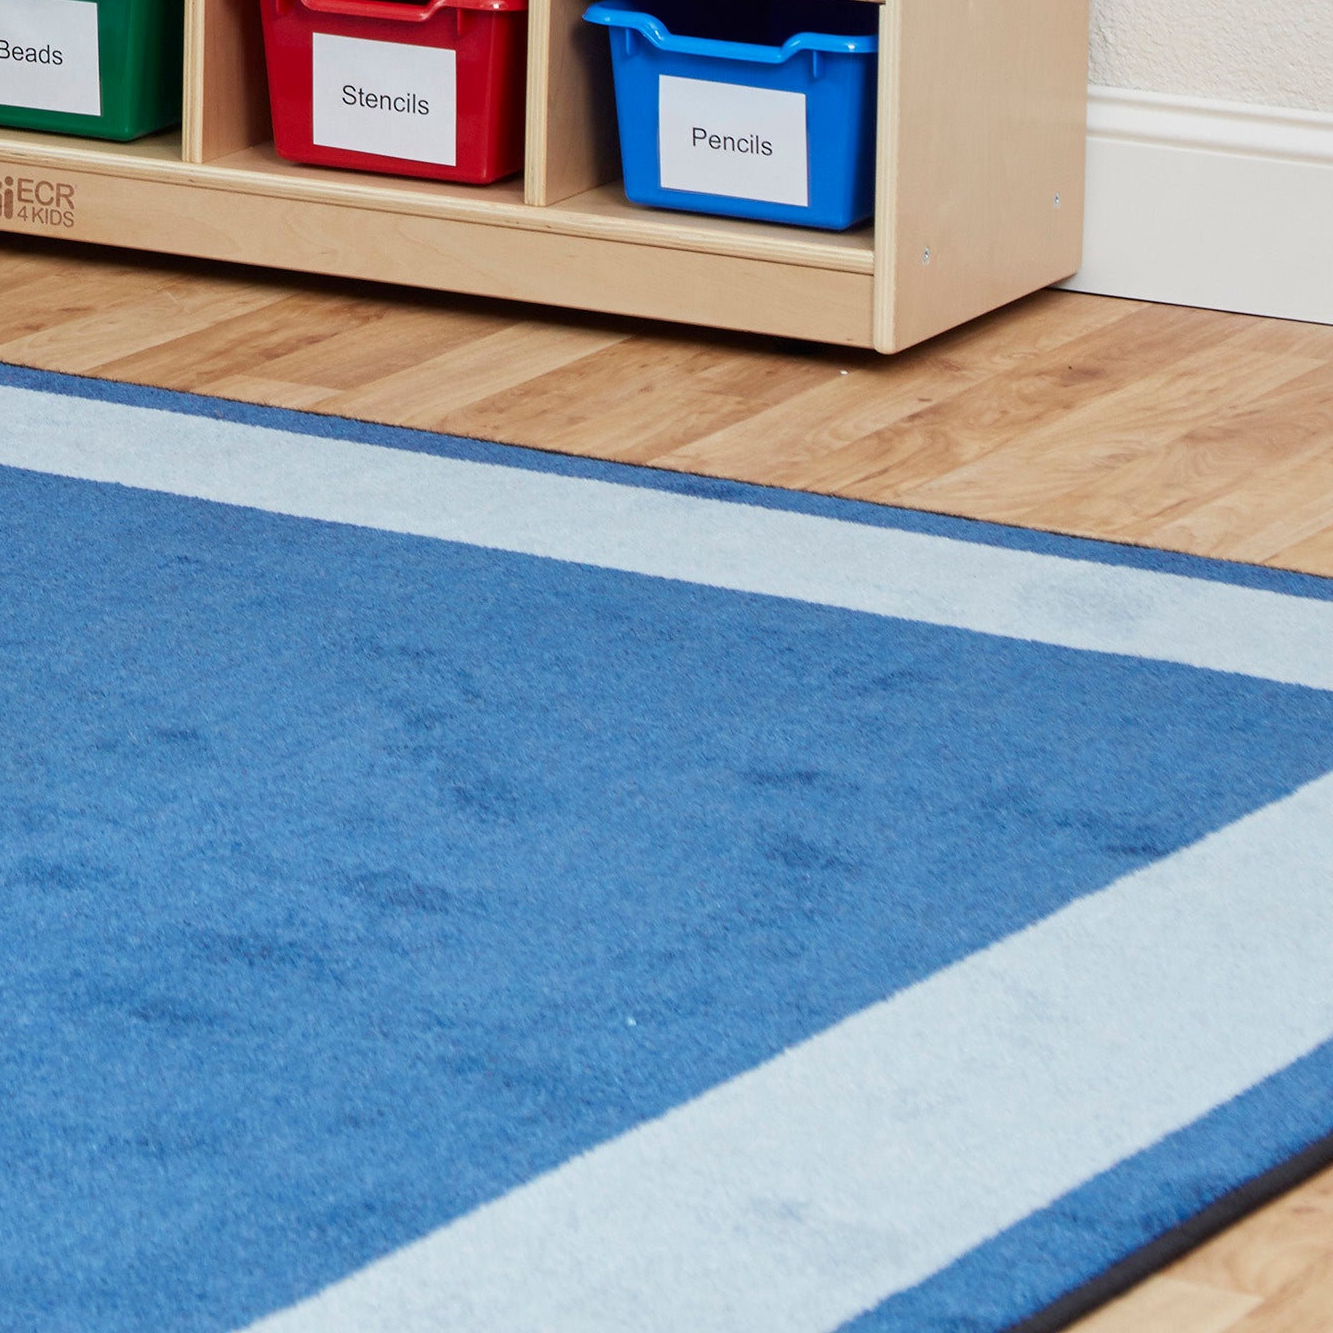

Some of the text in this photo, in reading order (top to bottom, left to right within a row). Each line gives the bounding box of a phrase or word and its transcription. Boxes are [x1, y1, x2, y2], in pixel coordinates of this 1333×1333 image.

[341, 84, 430, 116] Stencils
[692, 126, 773, 157] Pencils
[17, 177, 75, 210] ECR
[17, 205, 75, 228] 4 KIDS
